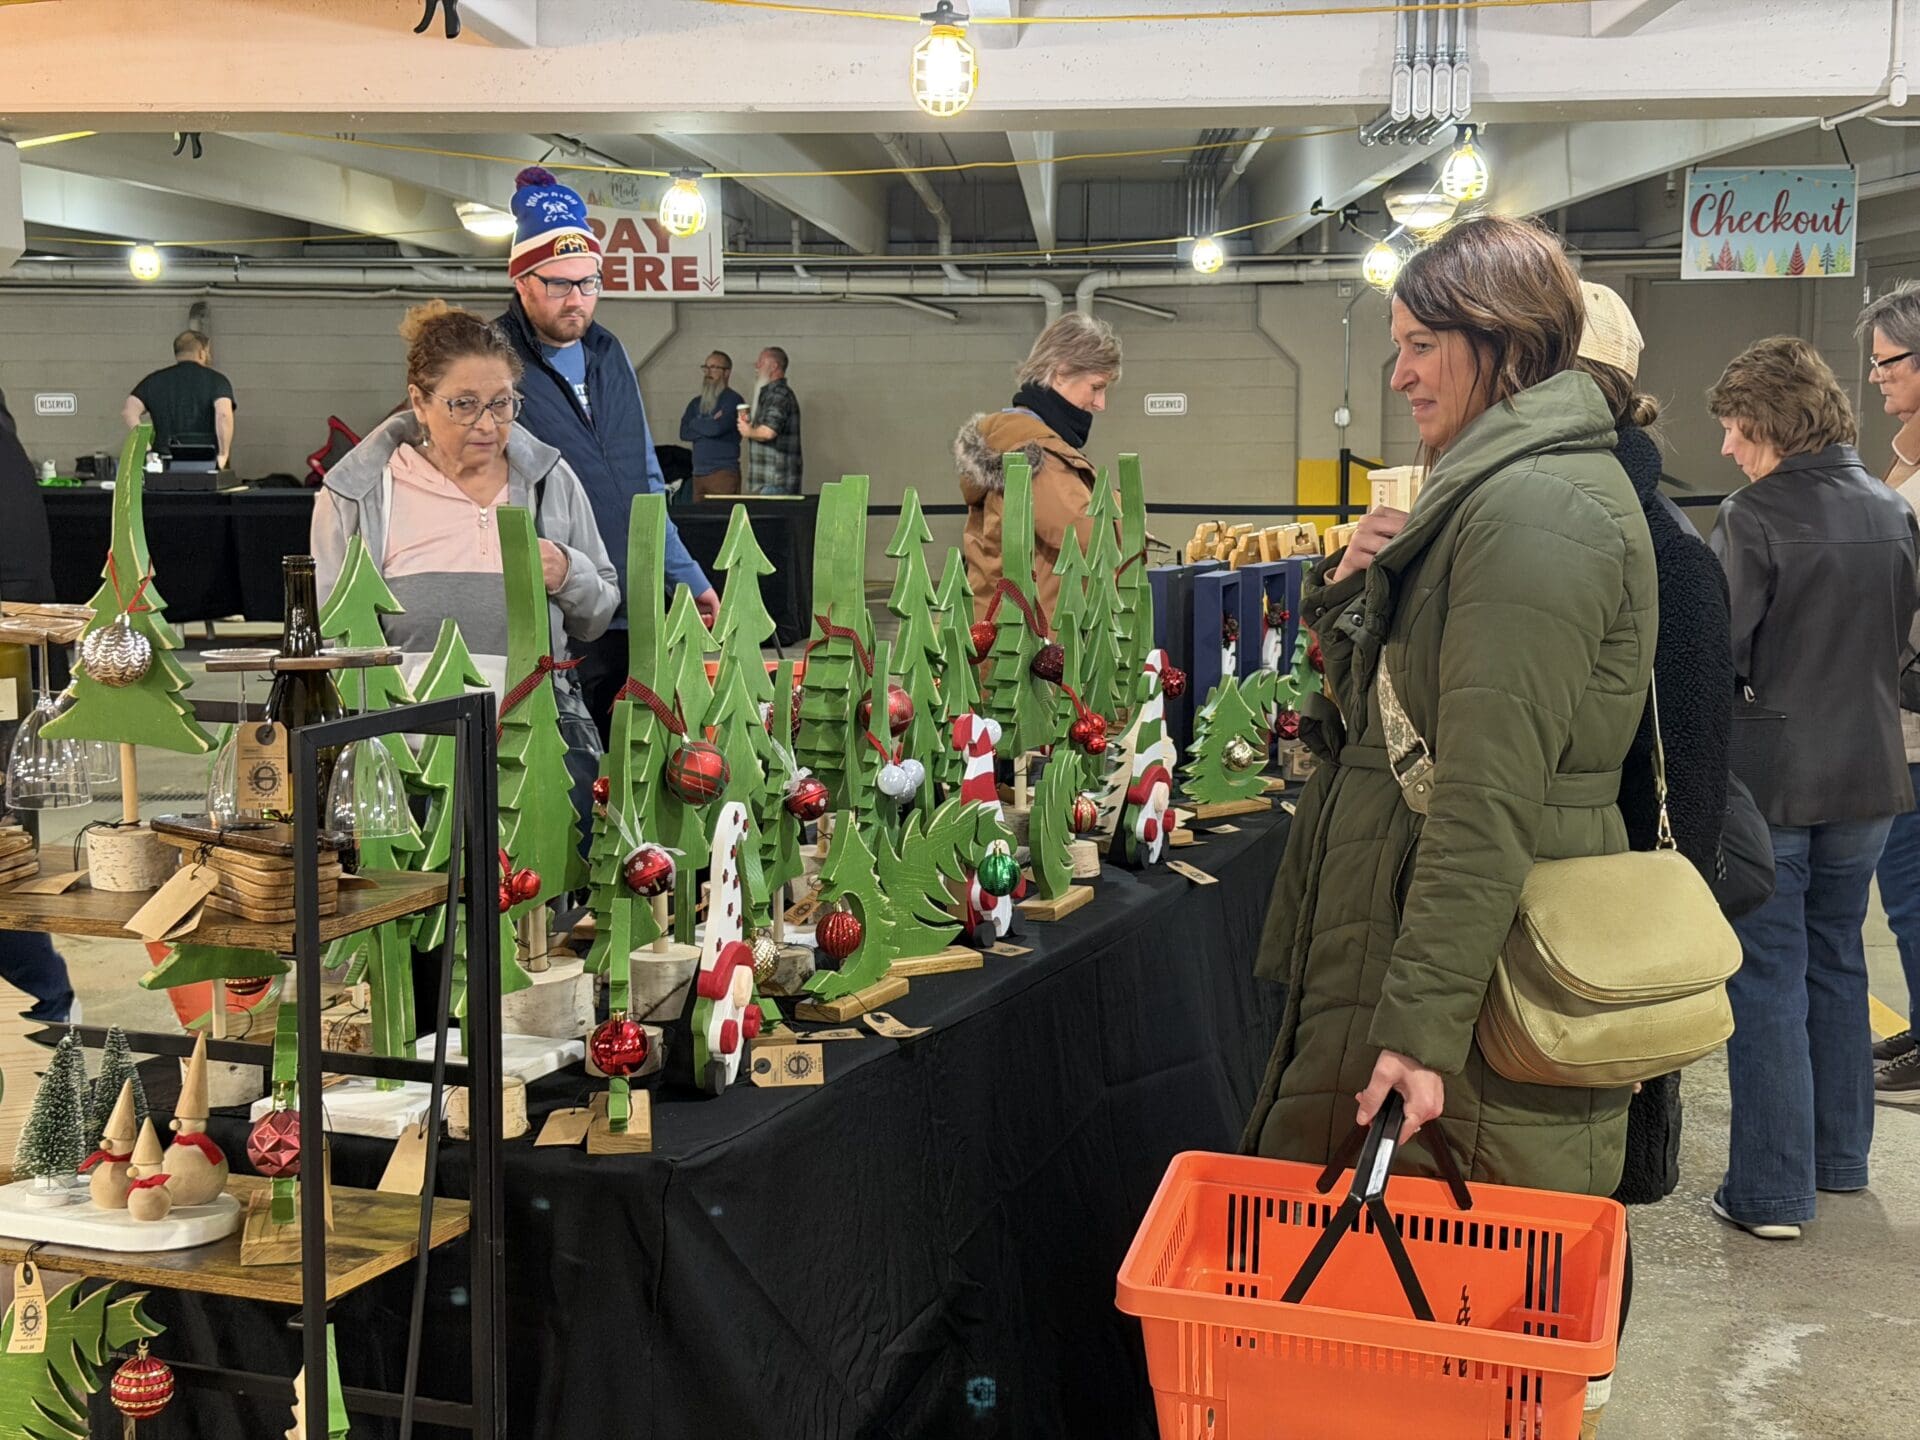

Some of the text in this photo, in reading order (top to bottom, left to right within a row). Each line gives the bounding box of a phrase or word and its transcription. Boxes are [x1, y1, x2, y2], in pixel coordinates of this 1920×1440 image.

[1689, 189, 1852, 237] Checkout
[601, 256, 700, 291] ERE
[40, 399, 72, 409] RESERVED
[1150, 399, 1182, 409] RESERVED
